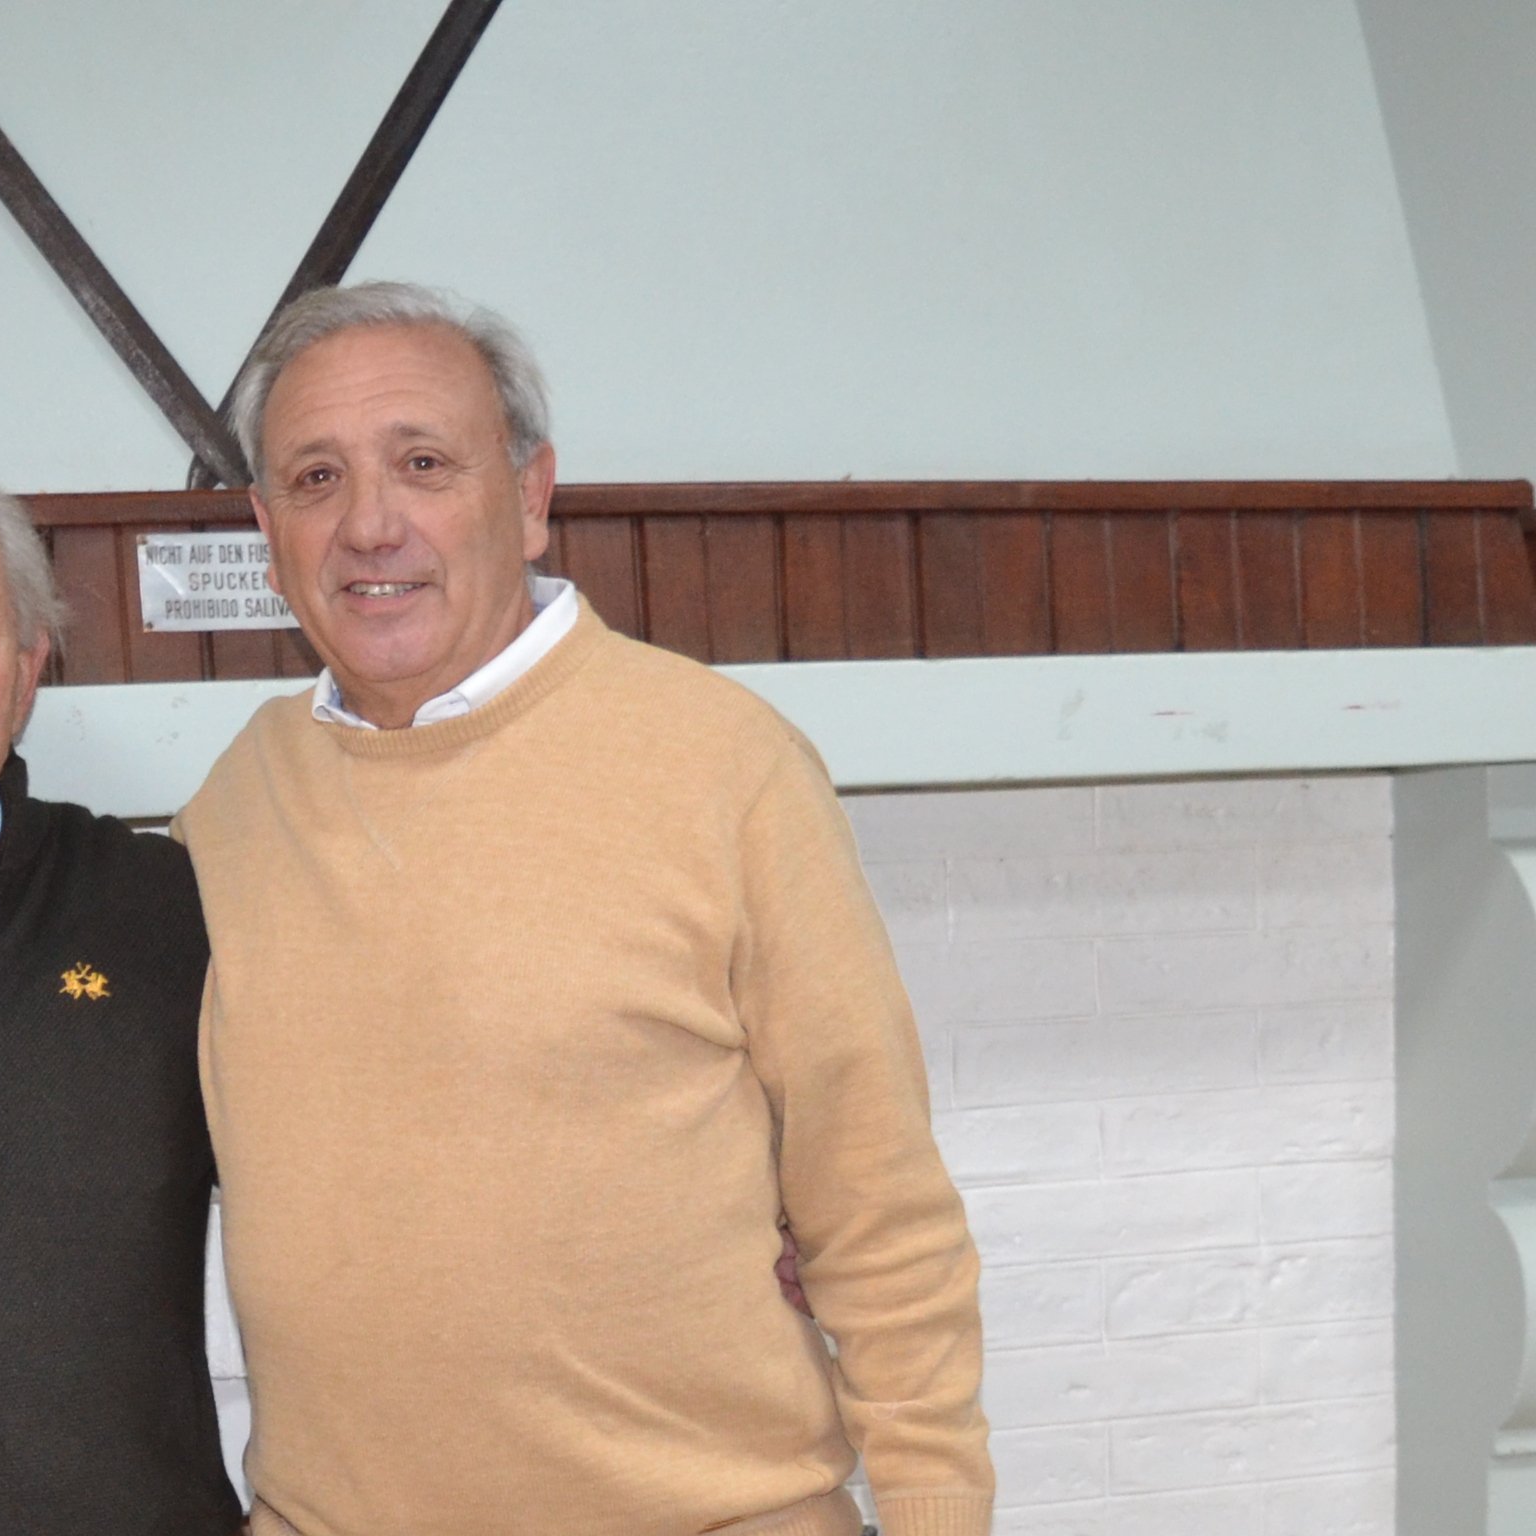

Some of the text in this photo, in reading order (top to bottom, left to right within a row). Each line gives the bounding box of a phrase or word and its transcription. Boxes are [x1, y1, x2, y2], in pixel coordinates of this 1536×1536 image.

[146, 545, 182, 565] NICHT
[189, 545, 213, 564] AUF
[219, 544, 243, 564] DEN
[166, 598, 239, 620] PROHIBIDO
